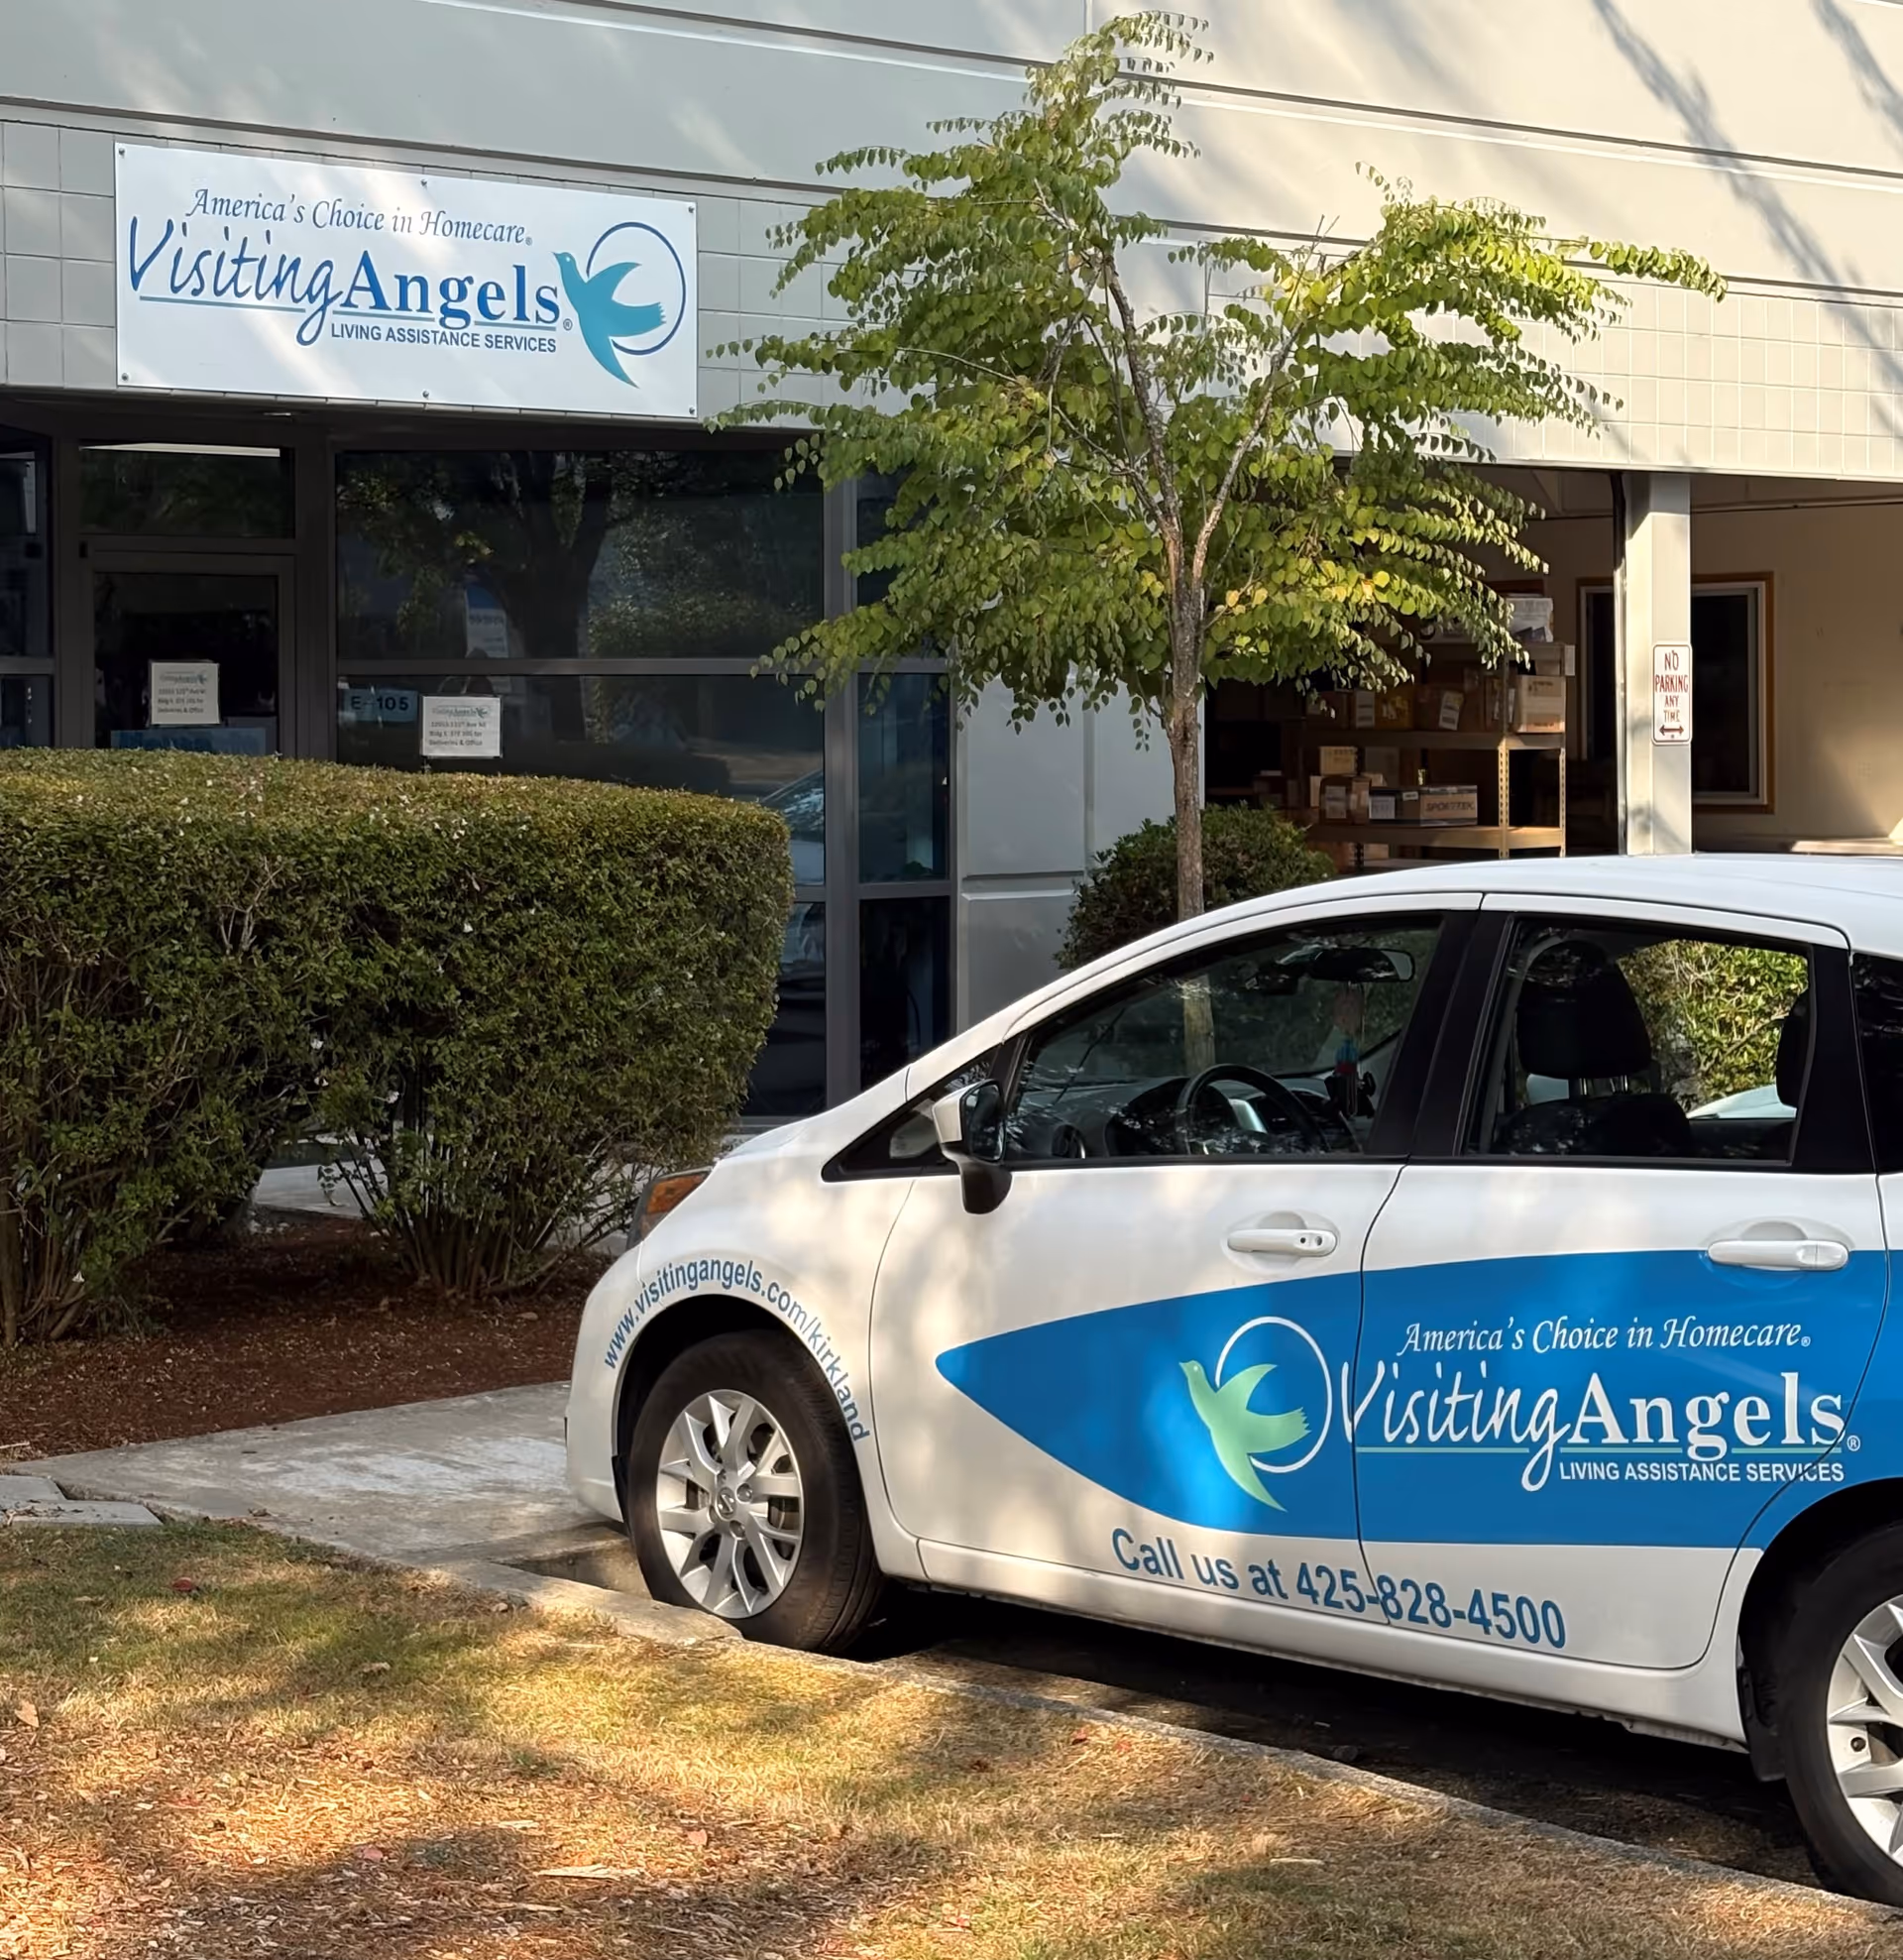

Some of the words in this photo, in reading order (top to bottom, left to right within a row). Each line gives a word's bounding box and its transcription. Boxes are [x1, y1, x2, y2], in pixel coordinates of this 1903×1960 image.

[312, 198, 385, 230] Choice
[392, 207, 412, 233] in
[130, 215, 344, 346] Visiting
[331, 323, 382, 341] LIVING
[386, 327, 480, 348] ASSISTANCE
[484, 334, 557, 352] SERVICES
[1664, 650, 1679, 671] NO
[1654, 674, 1688, 693] PARKING
[1663, 710, 1681, 723] TIME
[1665, 695, 1679, 707] ANY
[605, 1259, 870, 1441] www.visitingangels.com/kirkland
[1532, 1316, 1618, 1353] Choice
[1627, 1317, 1653, 1349] in
[1341, 1360, 1571, 1492] Visiting
[1559, 1462, 1620, 1480] LIVING
[1624, 1462, 1740, 1481] ASSISTANCE
[1746, 1463, 1845, 1482] SERVICES
[1112, 1528, 1184, 1580] Call
[1190, 1555, 1240, 1590] us
[1248, 1559, 1289, 1600] at
[1296, 1562, 1567, 1650] 425-828-4500
